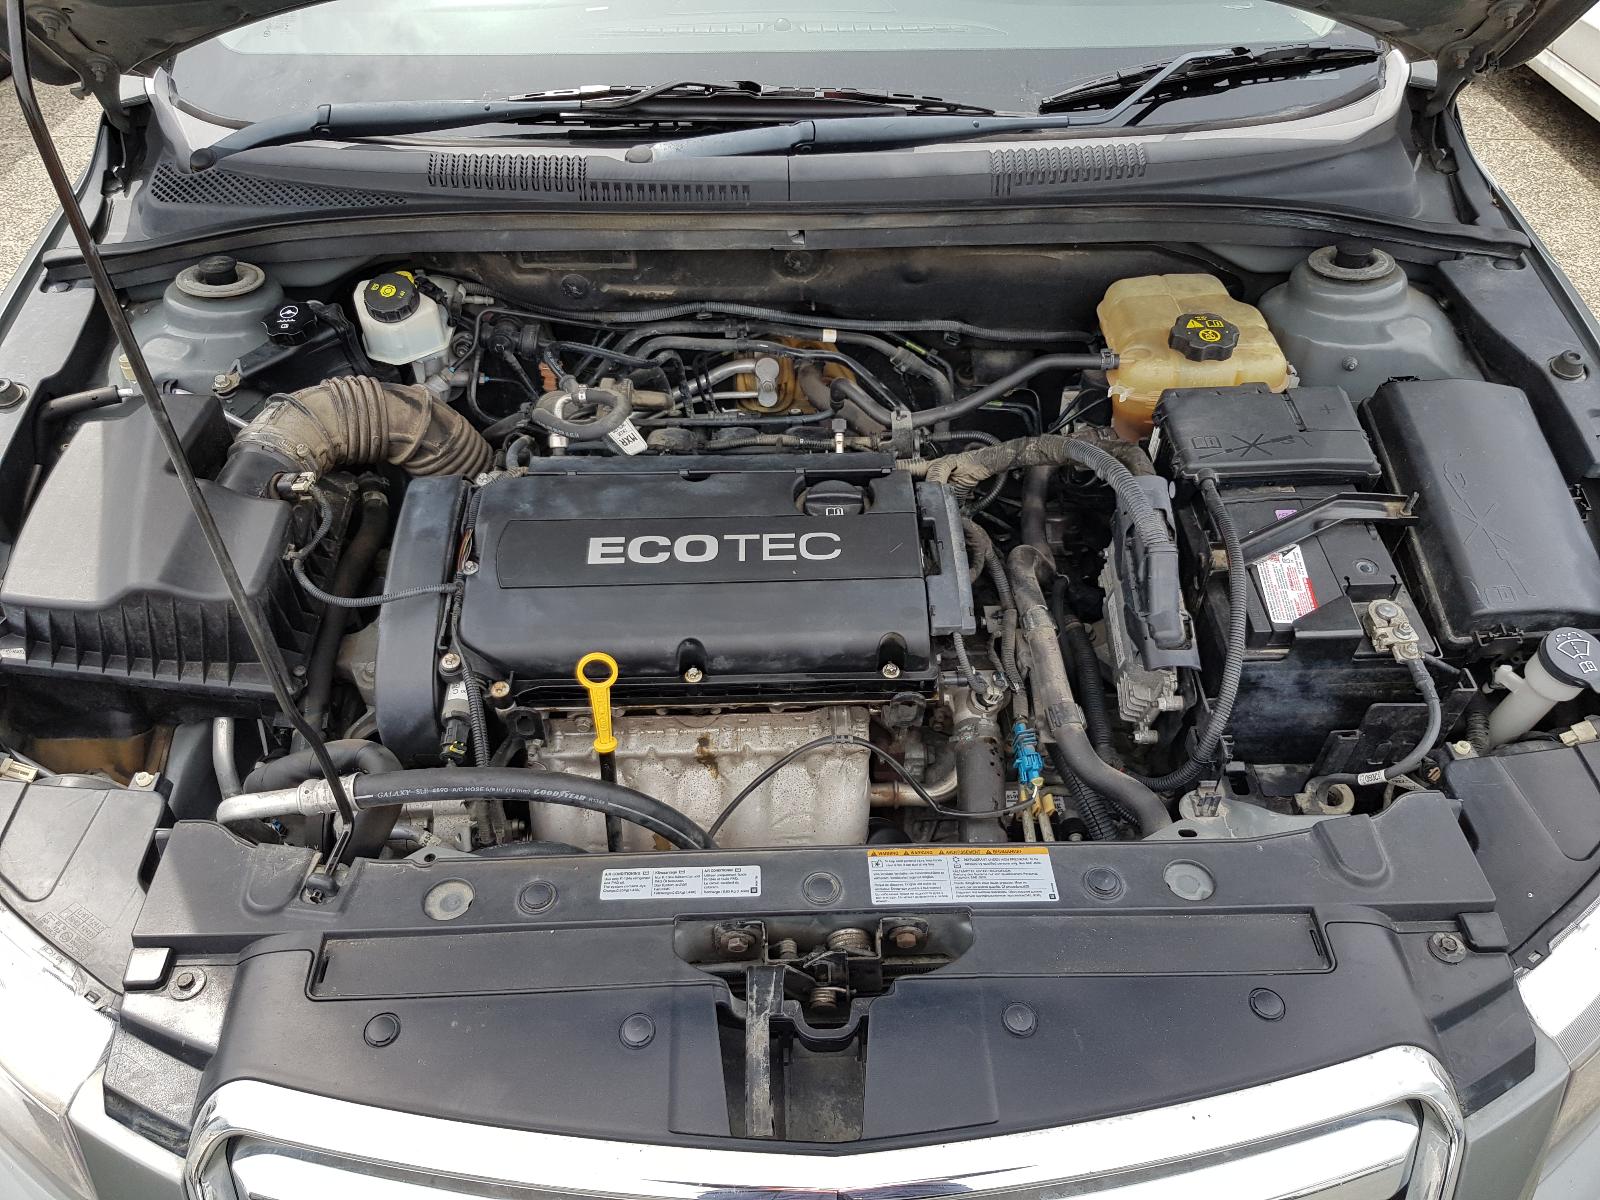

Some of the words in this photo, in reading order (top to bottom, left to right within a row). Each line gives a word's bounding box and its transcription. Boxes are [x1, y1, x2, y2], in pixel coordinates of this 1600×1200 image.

[618, 432, 639, 447] MXR
[587, 532, 842, 565] ECOTEC
[377, 789, 411, 799] GALAXY
[533, 788, 587, 801] GOODYEAR
